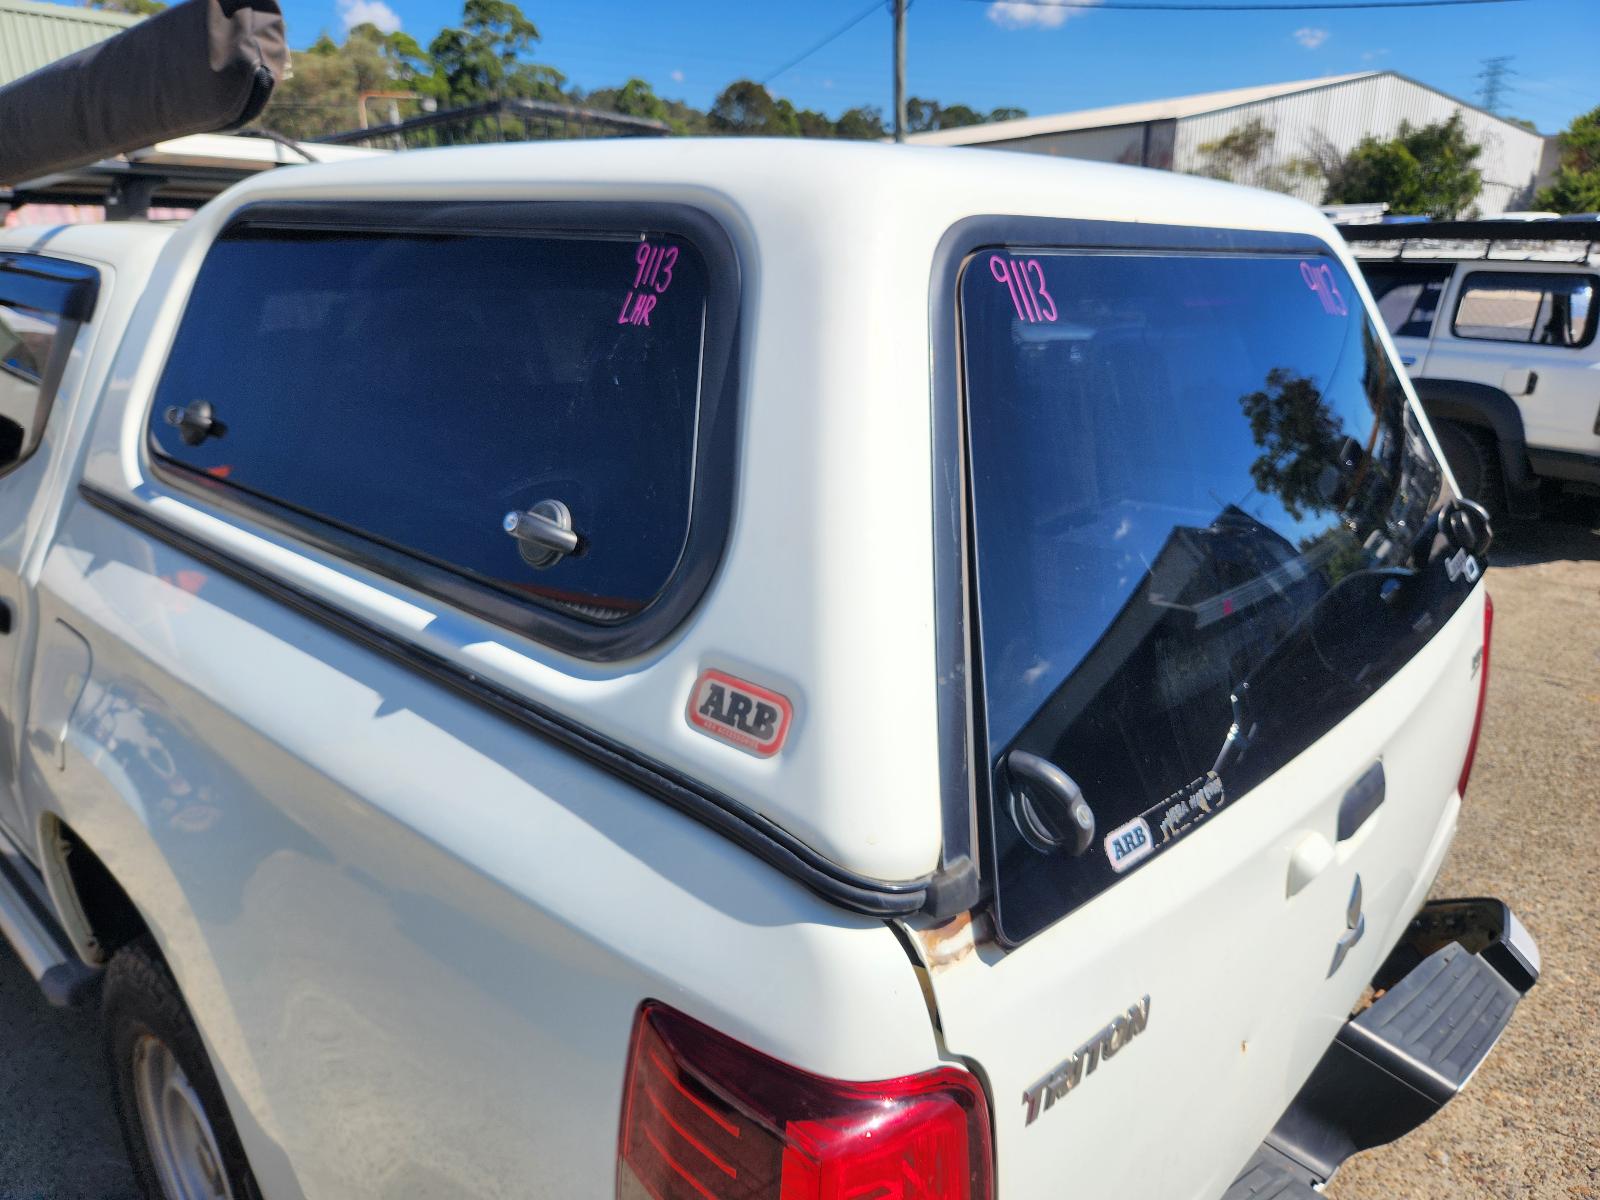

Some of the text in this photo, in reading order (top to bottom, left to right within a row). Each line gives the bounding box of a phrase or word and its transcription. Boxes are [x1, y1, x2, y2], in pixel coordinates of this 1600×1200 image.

[634, 242, 679, 293] 9113
[990, 255, 1058, 323] 9113
[699, 683, 777, 741] ARB
[1111, 825, 1147, 861] ARB
[1021, 993, 1151, 1128] TRITON
